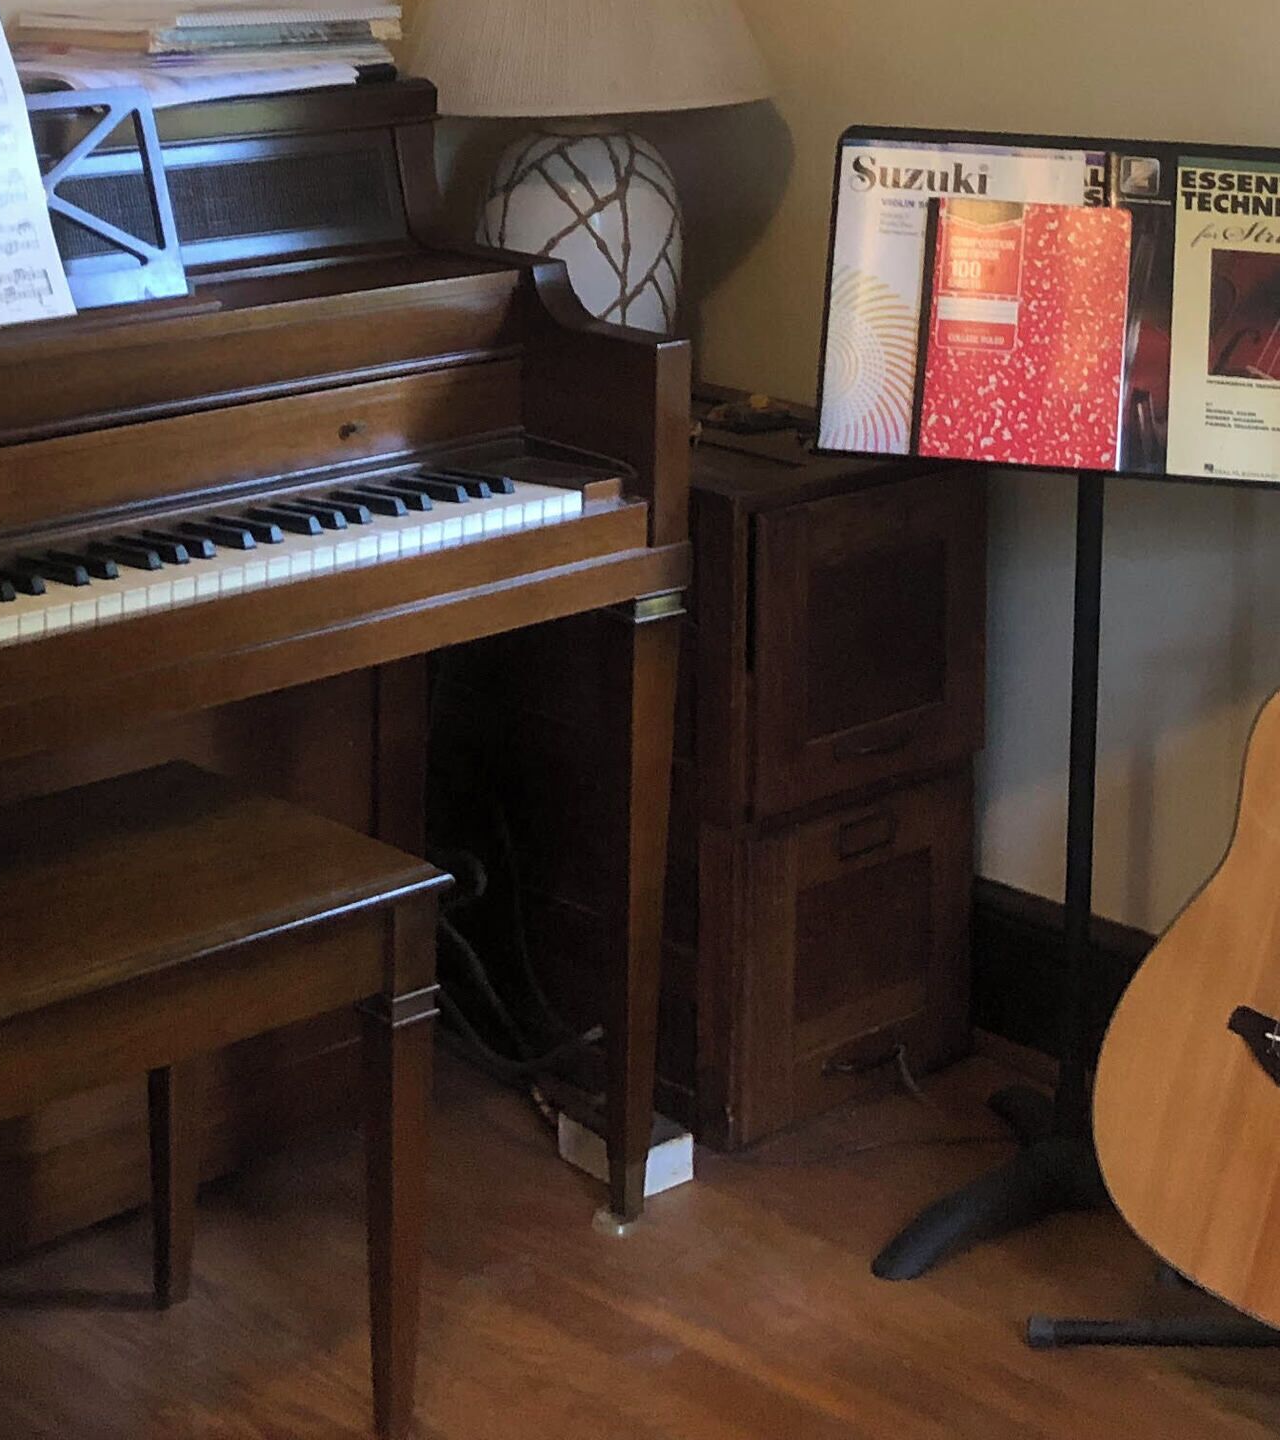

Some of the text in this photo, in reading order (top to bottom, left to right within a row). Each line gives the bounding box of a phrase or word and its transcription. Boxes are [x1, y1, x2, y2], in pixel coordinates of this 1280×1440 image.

[850, 154, 989, 194] Suzuki
[1191, 222, 1217, 248] for
[949, 259, 982, 278] 100
